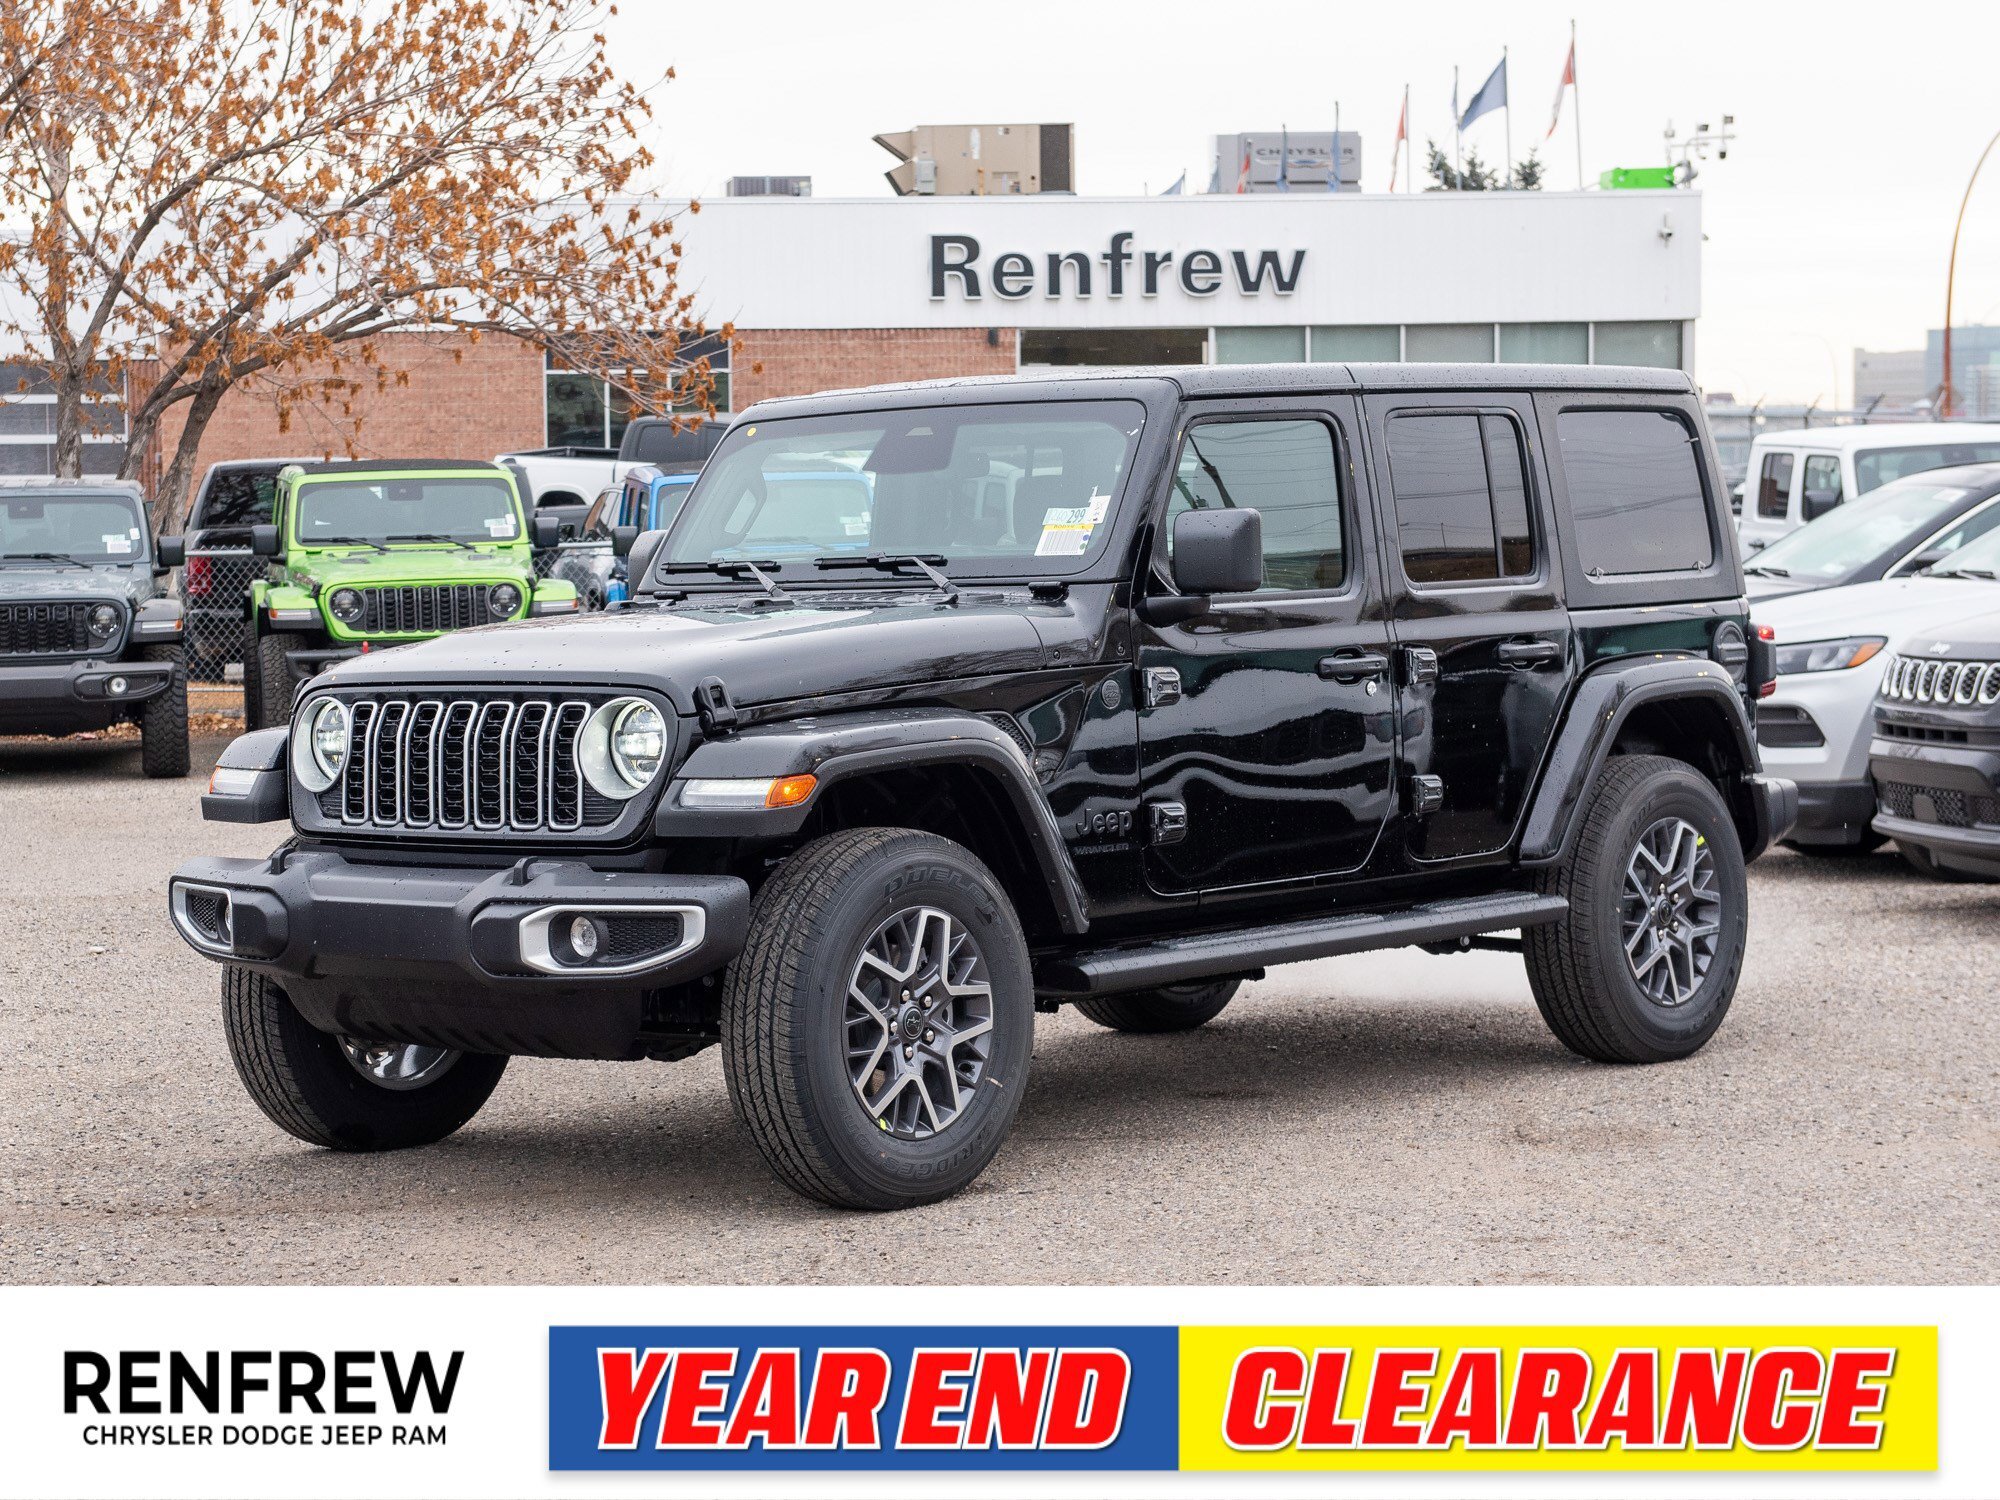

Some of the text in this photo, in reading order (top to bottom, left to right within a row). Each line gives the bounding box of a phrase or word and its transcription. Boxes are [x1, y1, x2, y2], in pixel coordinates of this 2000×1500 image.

[1256, 147, 1353, 156] CHRYSLR
[930, 232, 1307, 302] Renfrew
[1075, 808, 1133, 837] Jeep
[1073, 842, 1130, 855] WRANGLER
